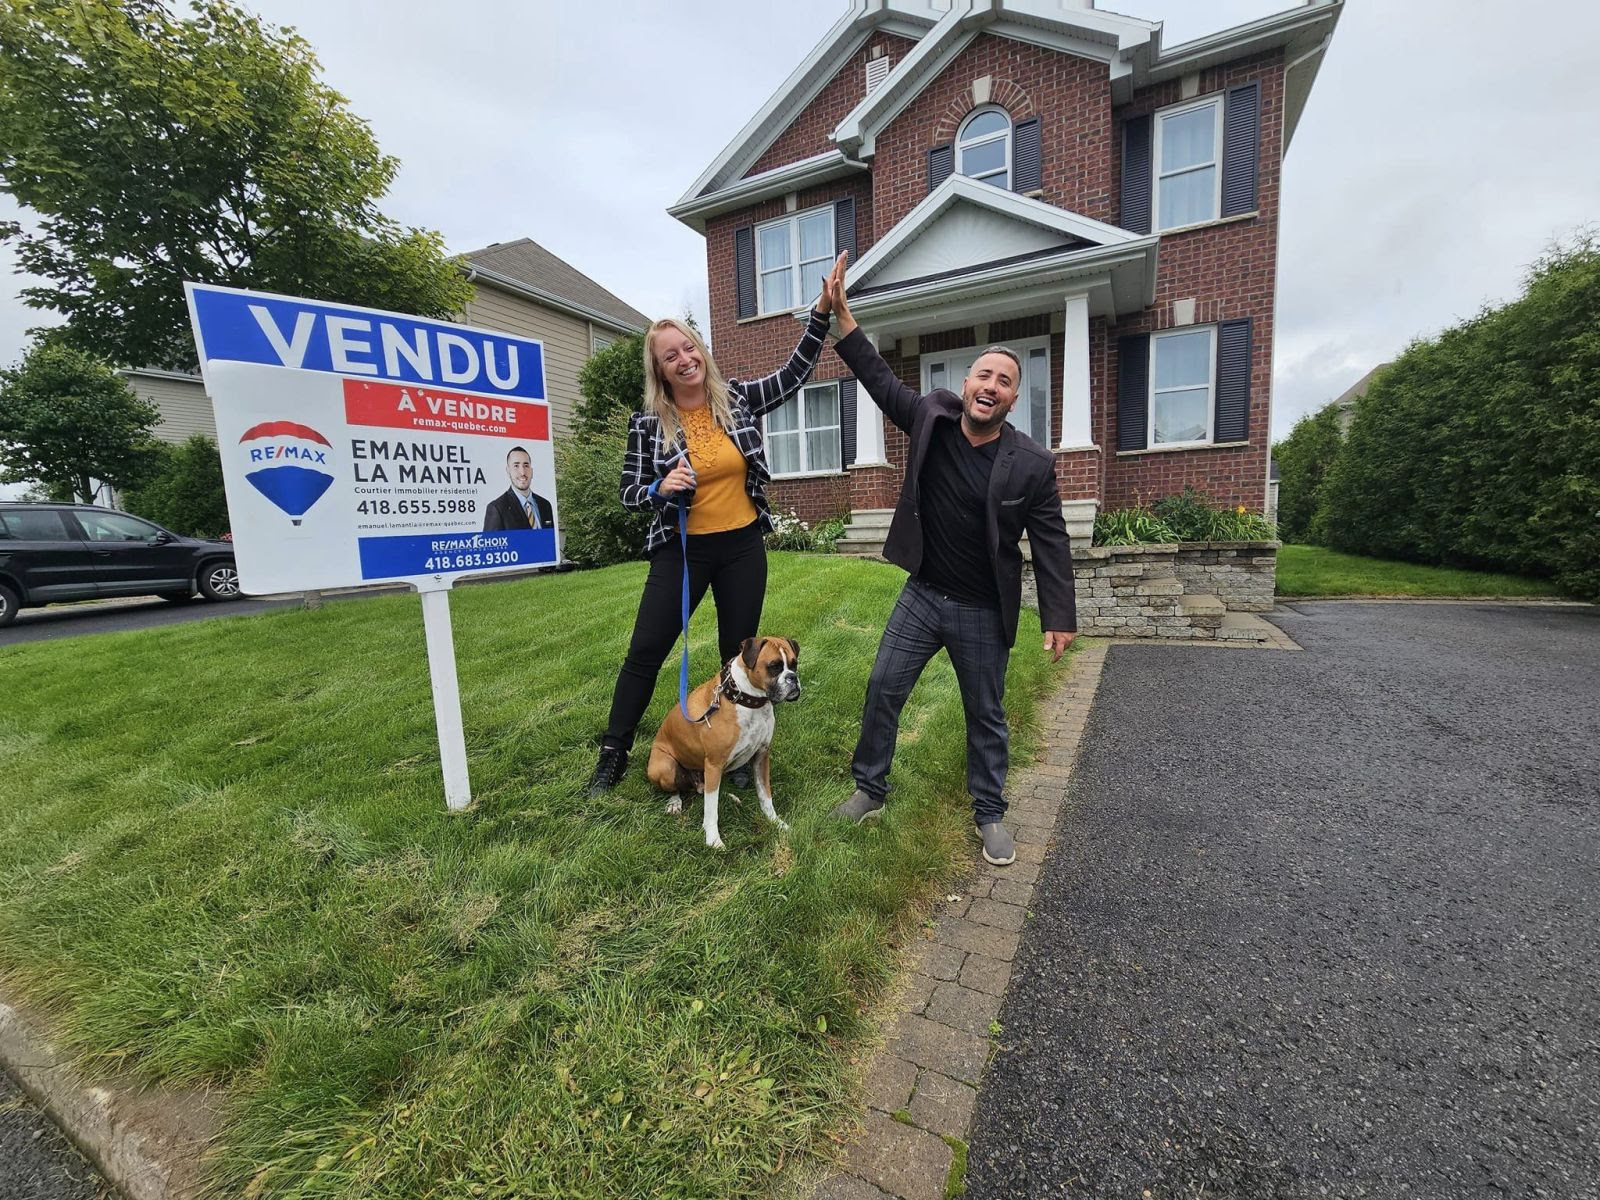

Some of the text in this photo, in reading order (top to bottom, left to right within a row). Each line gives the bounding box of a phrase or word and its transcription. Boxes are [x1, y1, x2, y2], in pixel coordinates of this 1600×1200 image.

[247, 304, 520, 390] VENDU
[397, 389, 517, 423] À VENDRE
[413, 417, 507, 433] remax-quebec.com
[250, 446, 326, 465] RE/MAX
[351, 439, 471, 463] EMANUEL
[353, 463, 487, 484] LA MANTIA
[354, 486, 478, 495] Courtier immobilier résidentiel
[356, 500, 476, 515] 418.655.5988
[431, 540, 472, 551] RE/MAX
[477, 537, 509, 548] CHOIX
[424, 551, 519, 570] 418.683.9300
